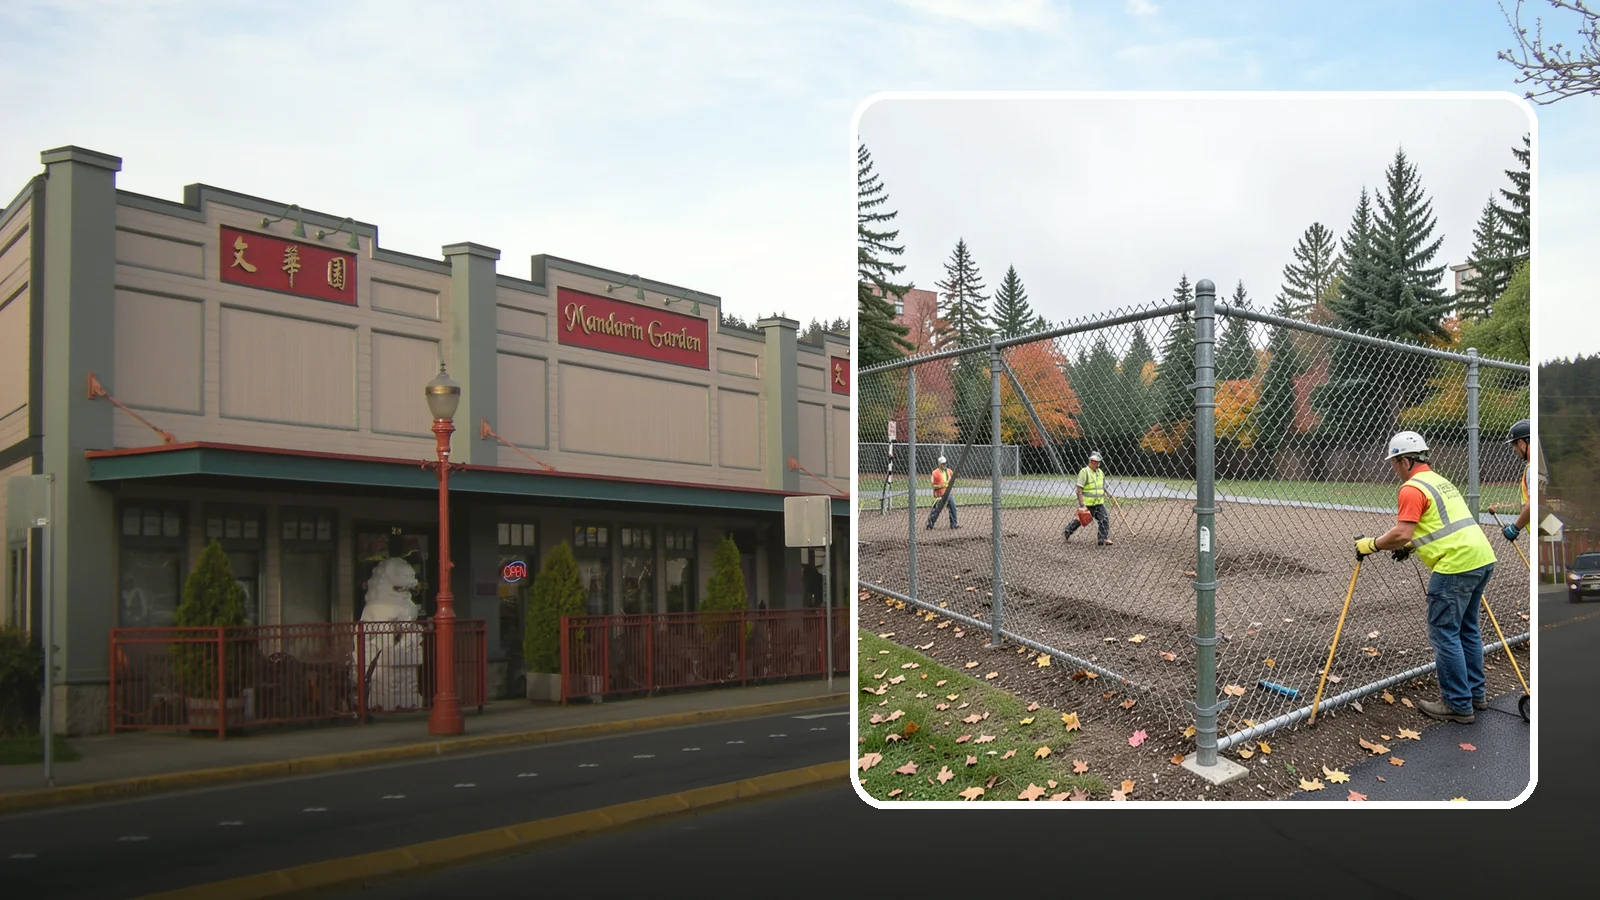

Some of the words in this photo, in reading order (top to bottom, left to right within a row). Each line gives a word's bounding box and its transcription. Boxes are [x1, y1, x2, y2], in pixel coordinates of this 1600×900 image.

[564, 302, 644, 341] Mandarin
[647, 320, 702, 352] Garden
[503, 565, 527, 578] OPEN
